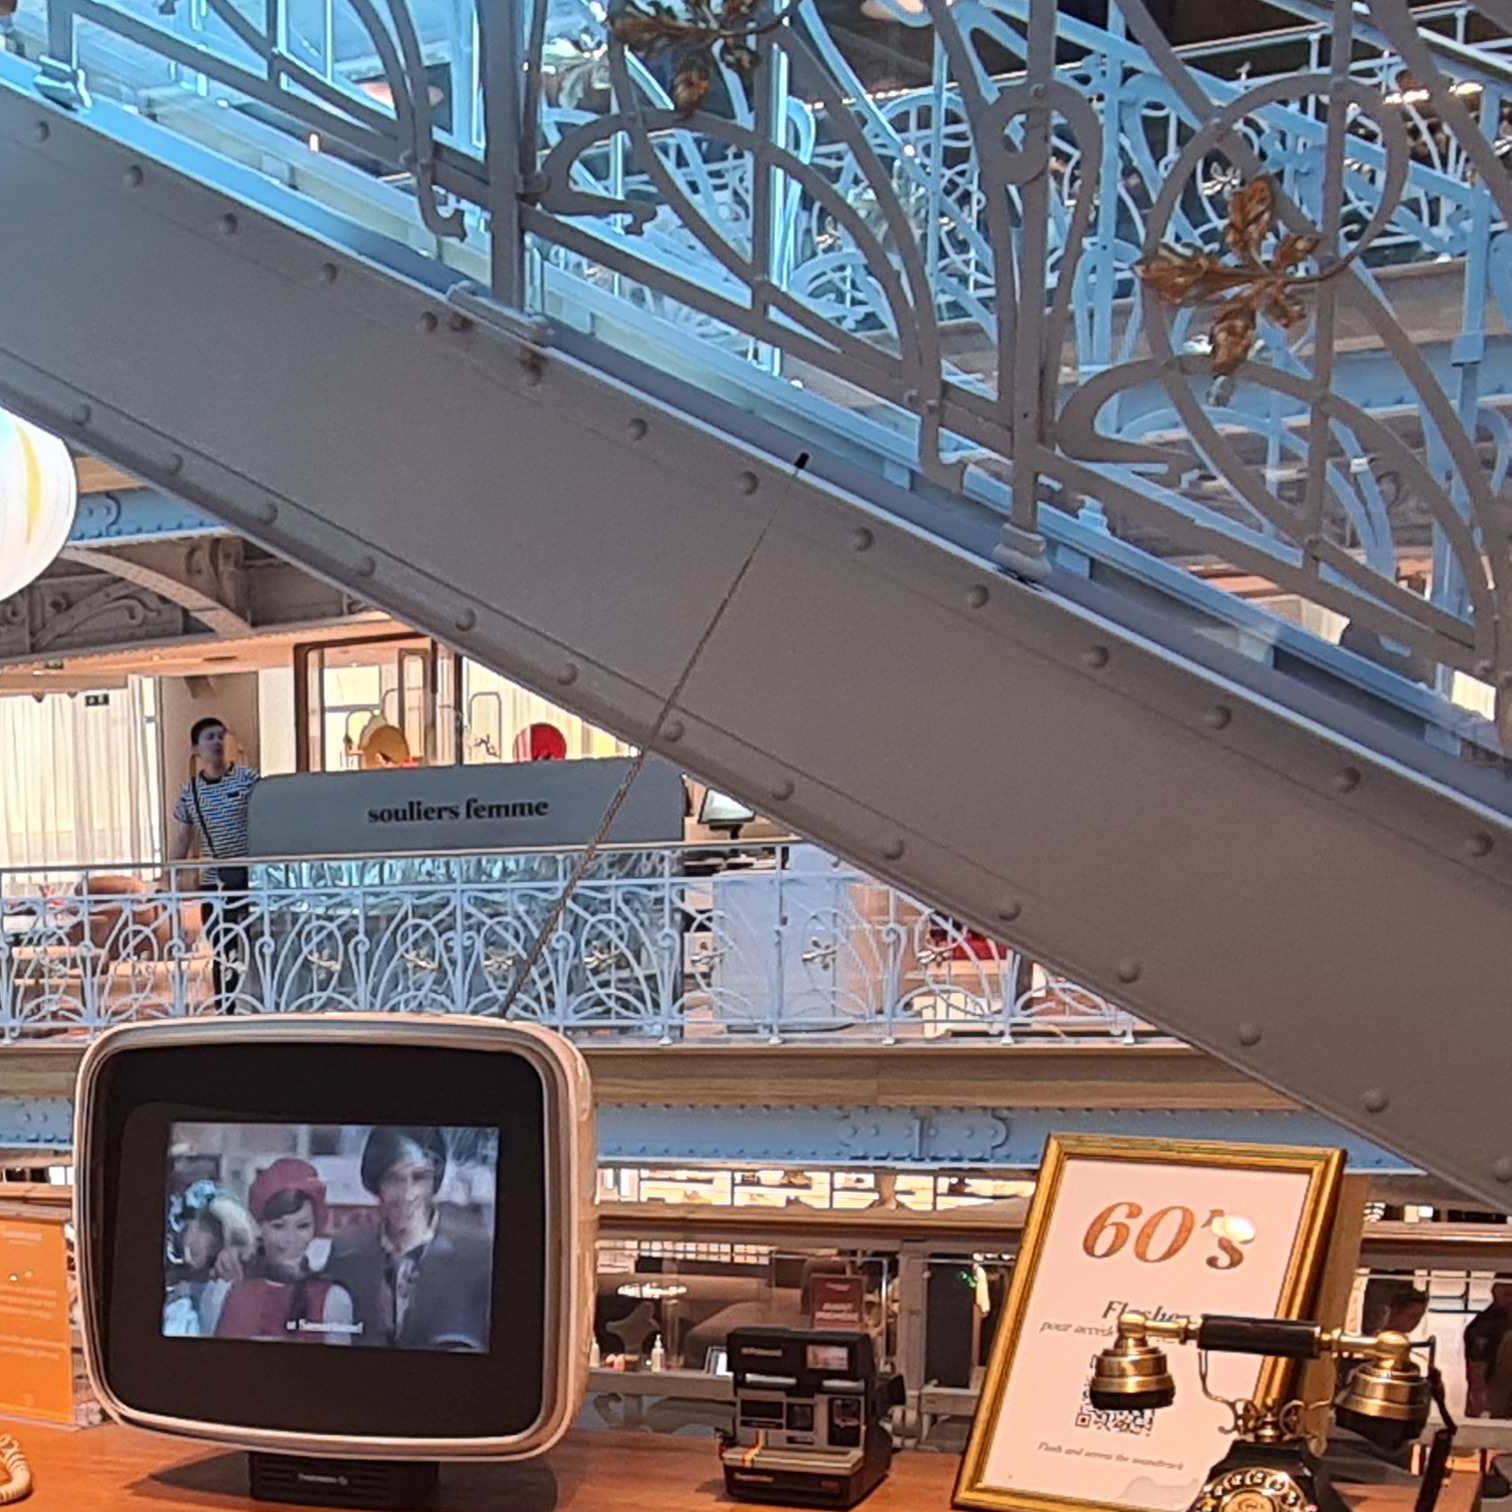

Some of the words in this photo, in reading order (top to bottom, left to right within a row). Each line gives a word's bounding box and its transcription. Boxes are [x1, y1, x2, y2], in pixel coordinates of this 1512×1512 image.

[368, 801, 460, 823] souliers
[465, 798, 549, 820] femme
[1082, 1202, 1255, 1270] 60's
